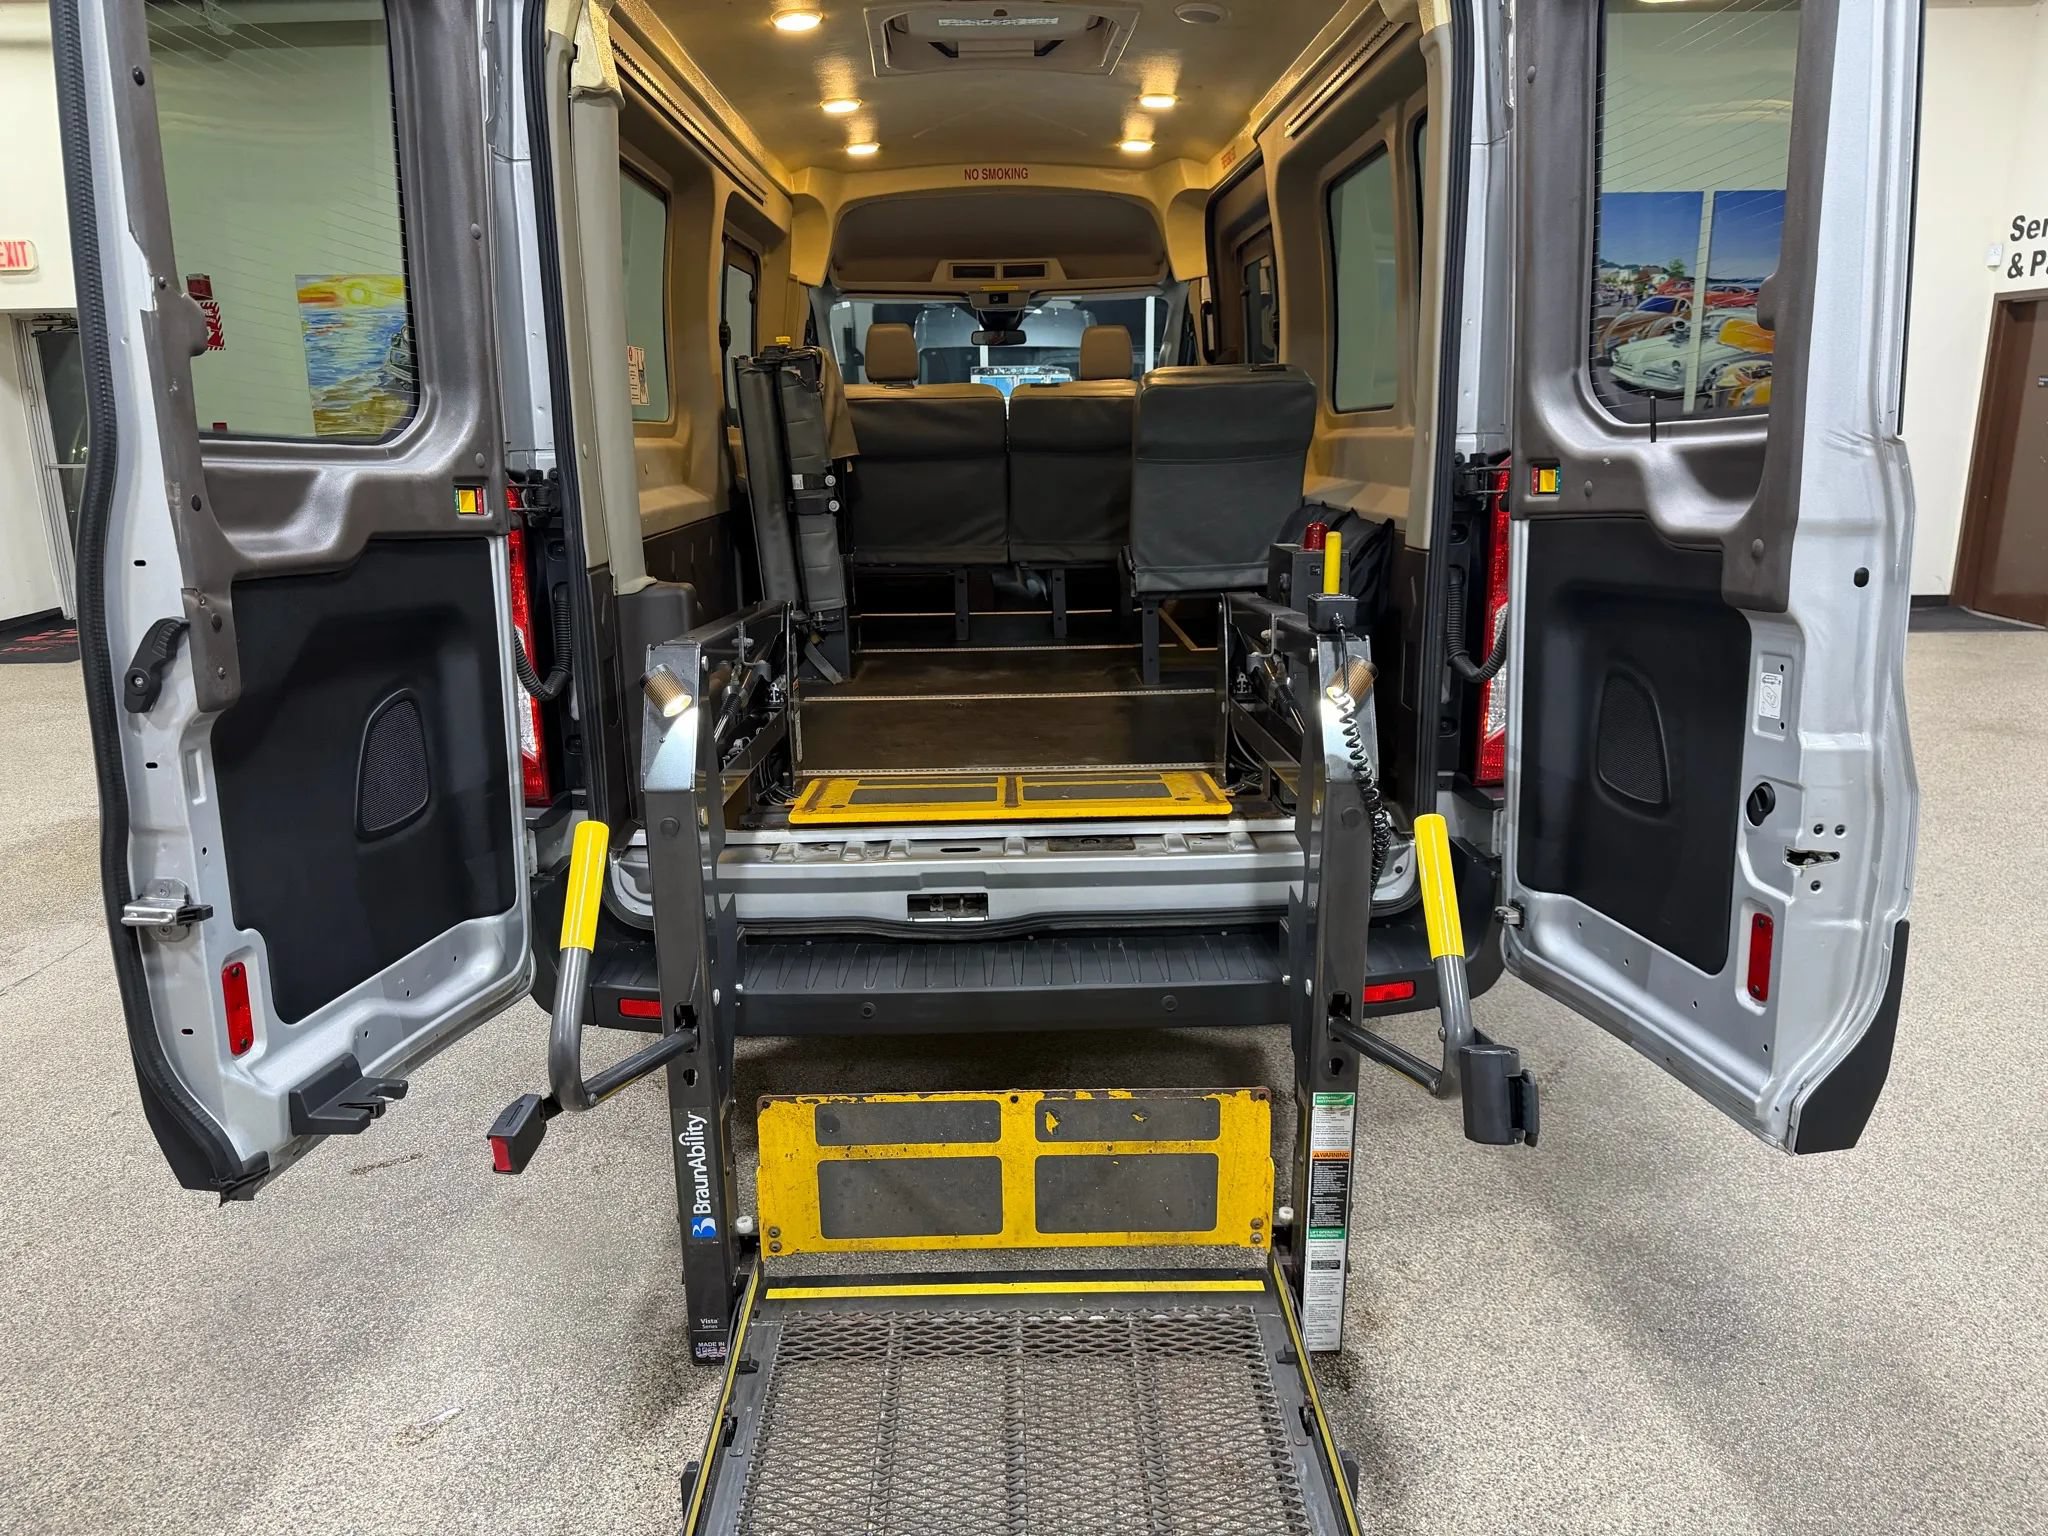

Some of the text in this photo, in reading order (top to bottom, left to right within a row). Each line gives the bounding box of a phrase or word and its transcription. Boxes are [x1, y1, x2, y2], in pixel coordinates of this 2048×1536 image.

[964, 167, 1029, 180] NO SMOKING
[2007, 249, 2048, 279] & P
[679, 1113, 711, 1214] BraunAbility
[695, 1346, 727, 1358] USA
